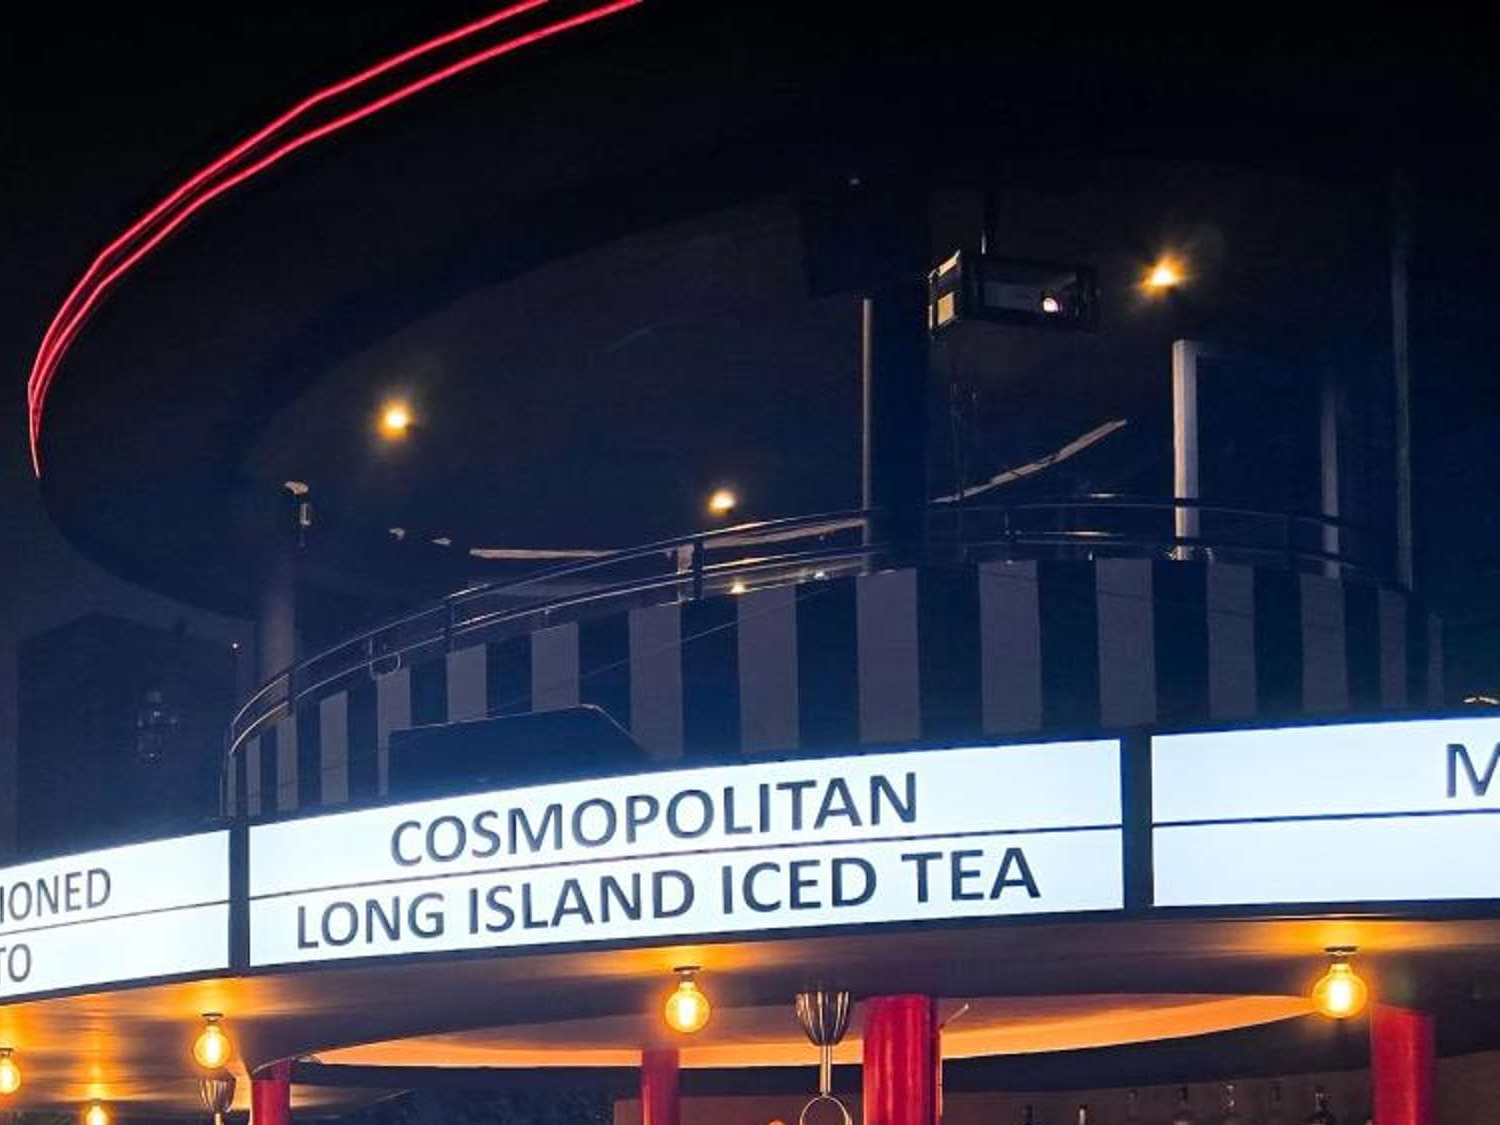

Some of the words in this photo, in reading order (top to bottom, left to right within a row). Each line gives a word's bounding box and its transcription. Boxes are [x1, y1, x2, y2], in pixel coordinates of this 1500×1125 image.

[391, 771, 917, 866] COSMOPOLITAN
[297, 892, 445, 950] LONG
[469, 869, 695, 935] ISLAND
[721, 857, 877, 915] ICED
[900, 847, 1042, 904] TEA
